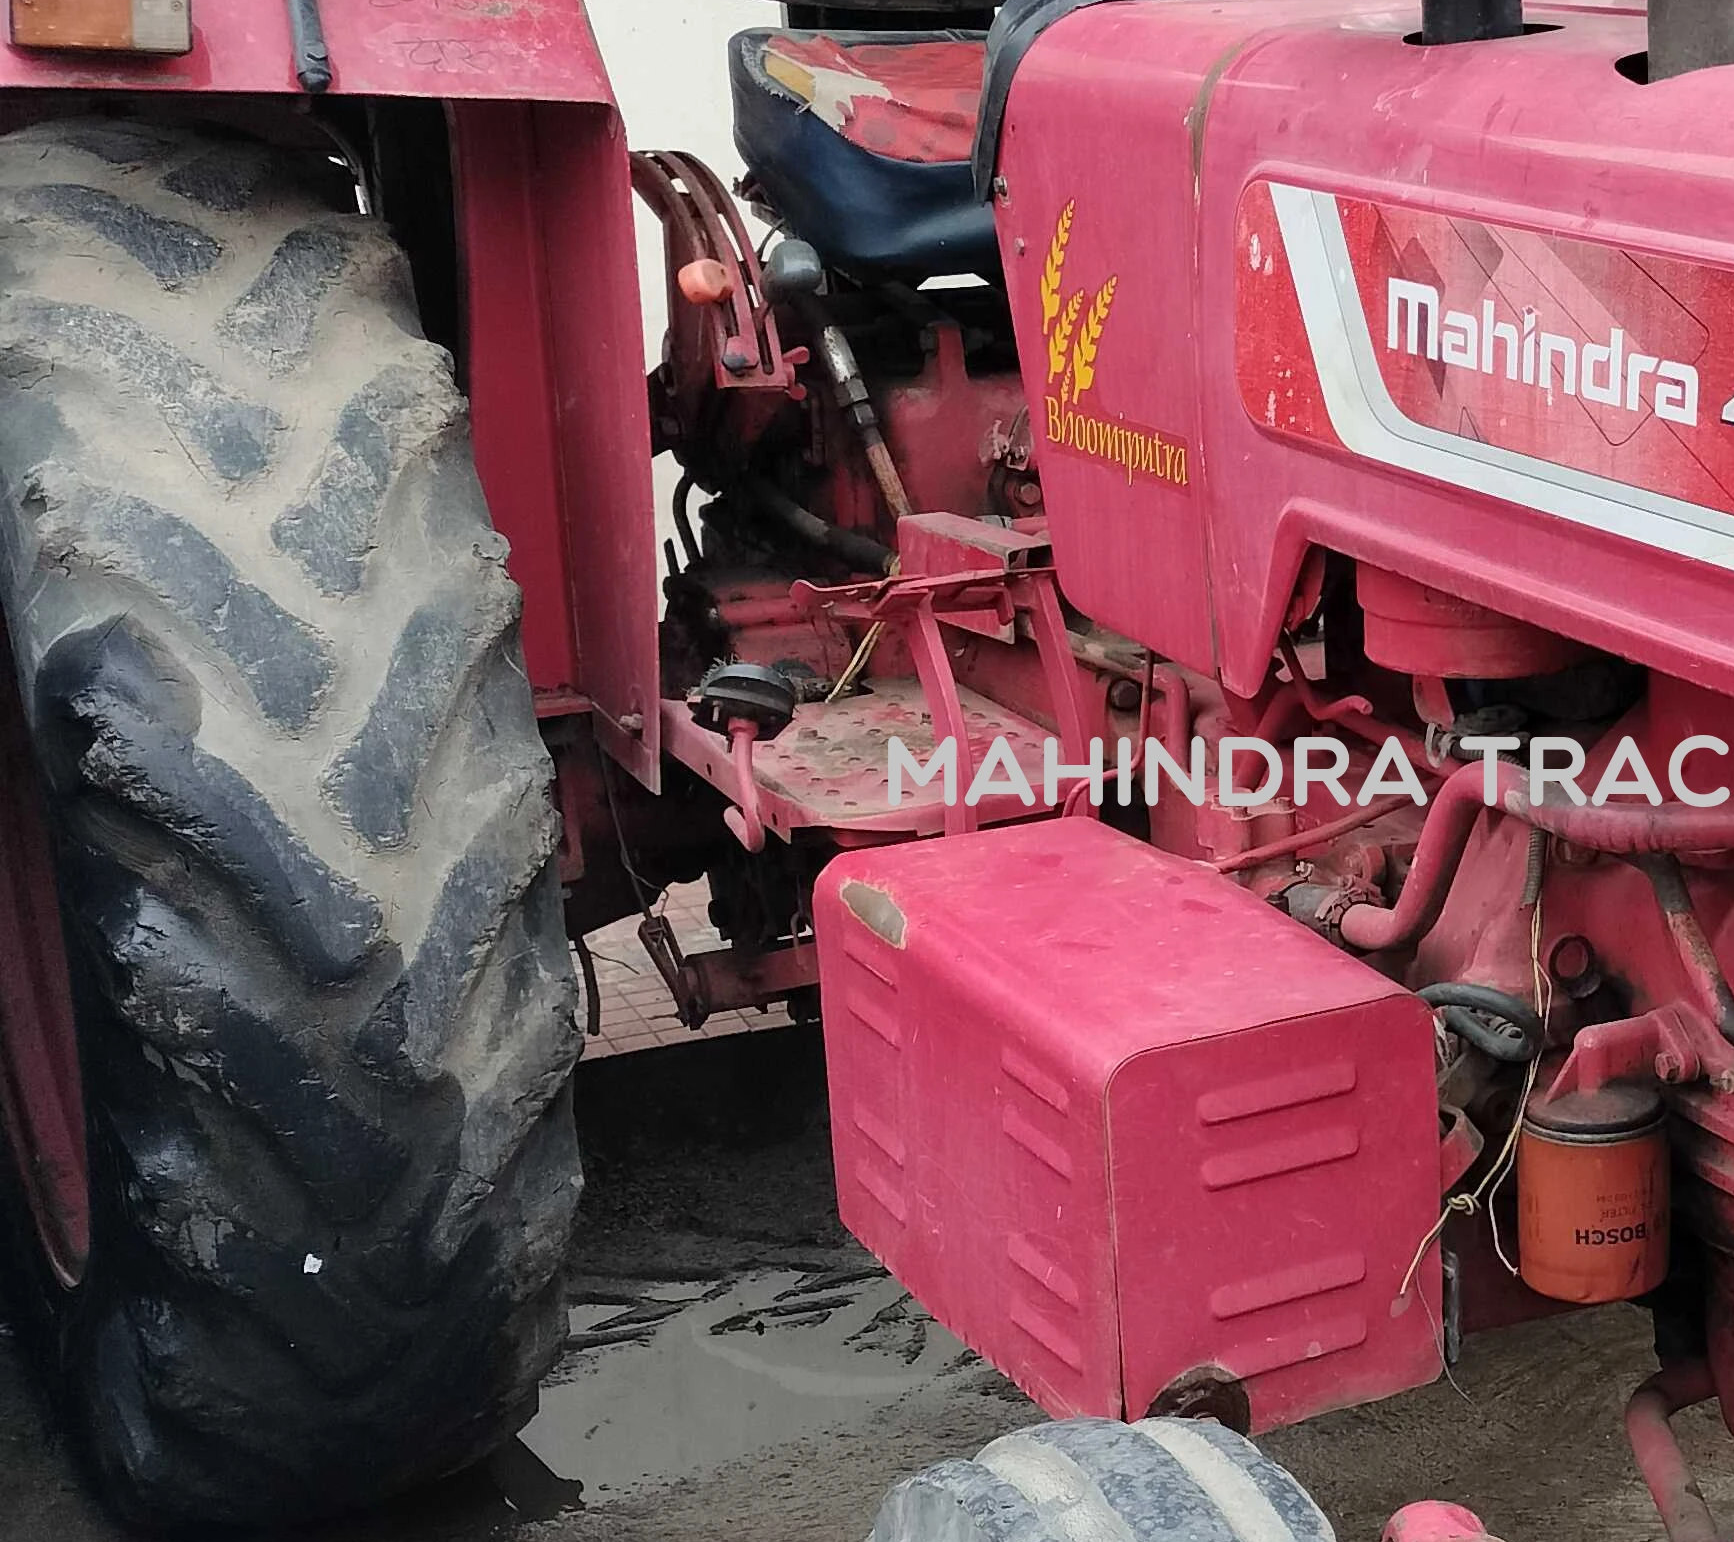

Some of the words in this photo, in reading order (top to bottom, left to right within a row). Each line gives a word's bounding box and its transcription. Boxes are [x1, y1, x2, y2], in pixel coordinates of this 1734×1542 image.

[1387, 277, 1698, 427] Mahindra
[1045, 395, 1188, 486] Bhoomiputra
[1575, 1221, 1648, 1246] BOSCH
